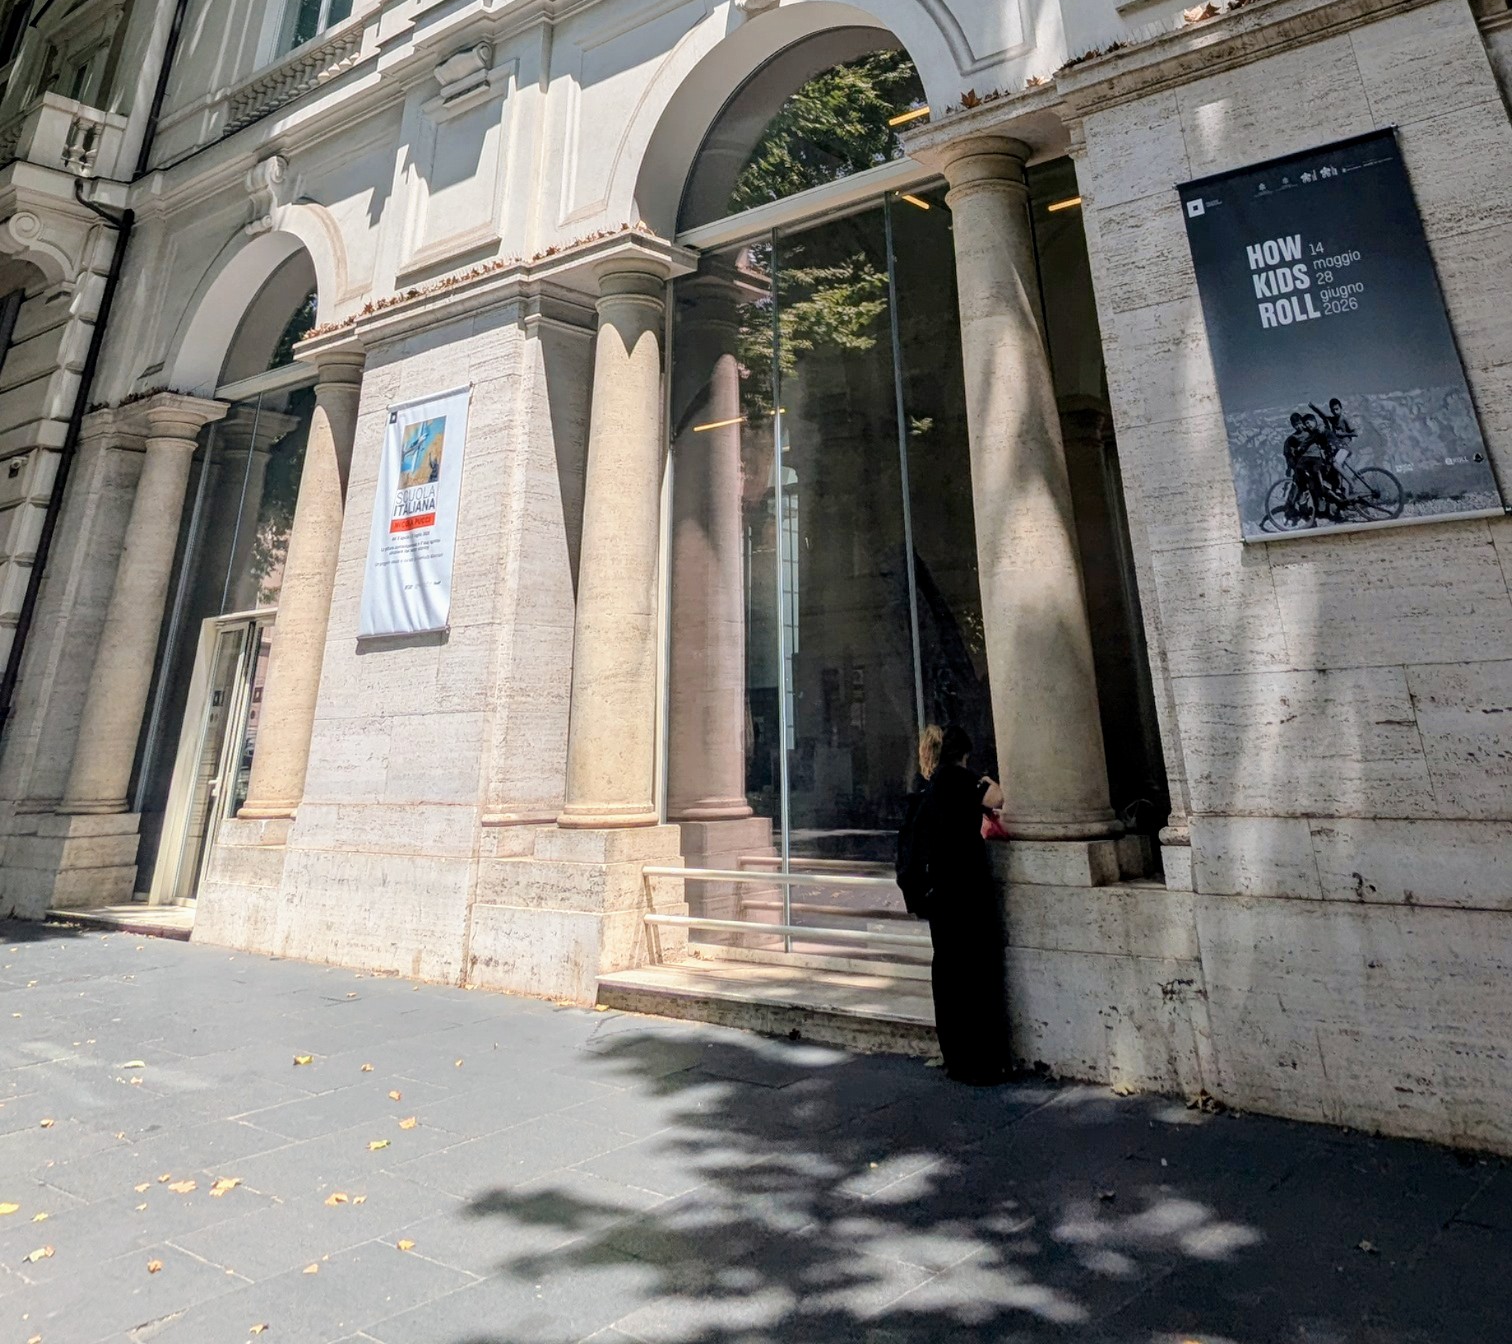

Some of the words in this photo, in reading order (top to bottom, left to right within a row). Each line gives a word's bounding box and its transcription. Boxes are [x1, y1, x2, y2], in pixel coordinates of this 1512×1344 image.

[1246, 234, 1302, 270] HOW
[1309, 242, 1324, 256] 14
[1313, 250, 1361, 269] maggio
[1252, 264, 1311, 299] KIDS
[1316, 271, 1334, 285] 28
[1320, 282, 1364, 303] giugno
[1258, 293, 1321, 328] ROLL
[1323, 297, 1358, 315] 2026
[396, 485, 435, 505] SCUOLA
[394, 498, 436, 517] ITALIANA
